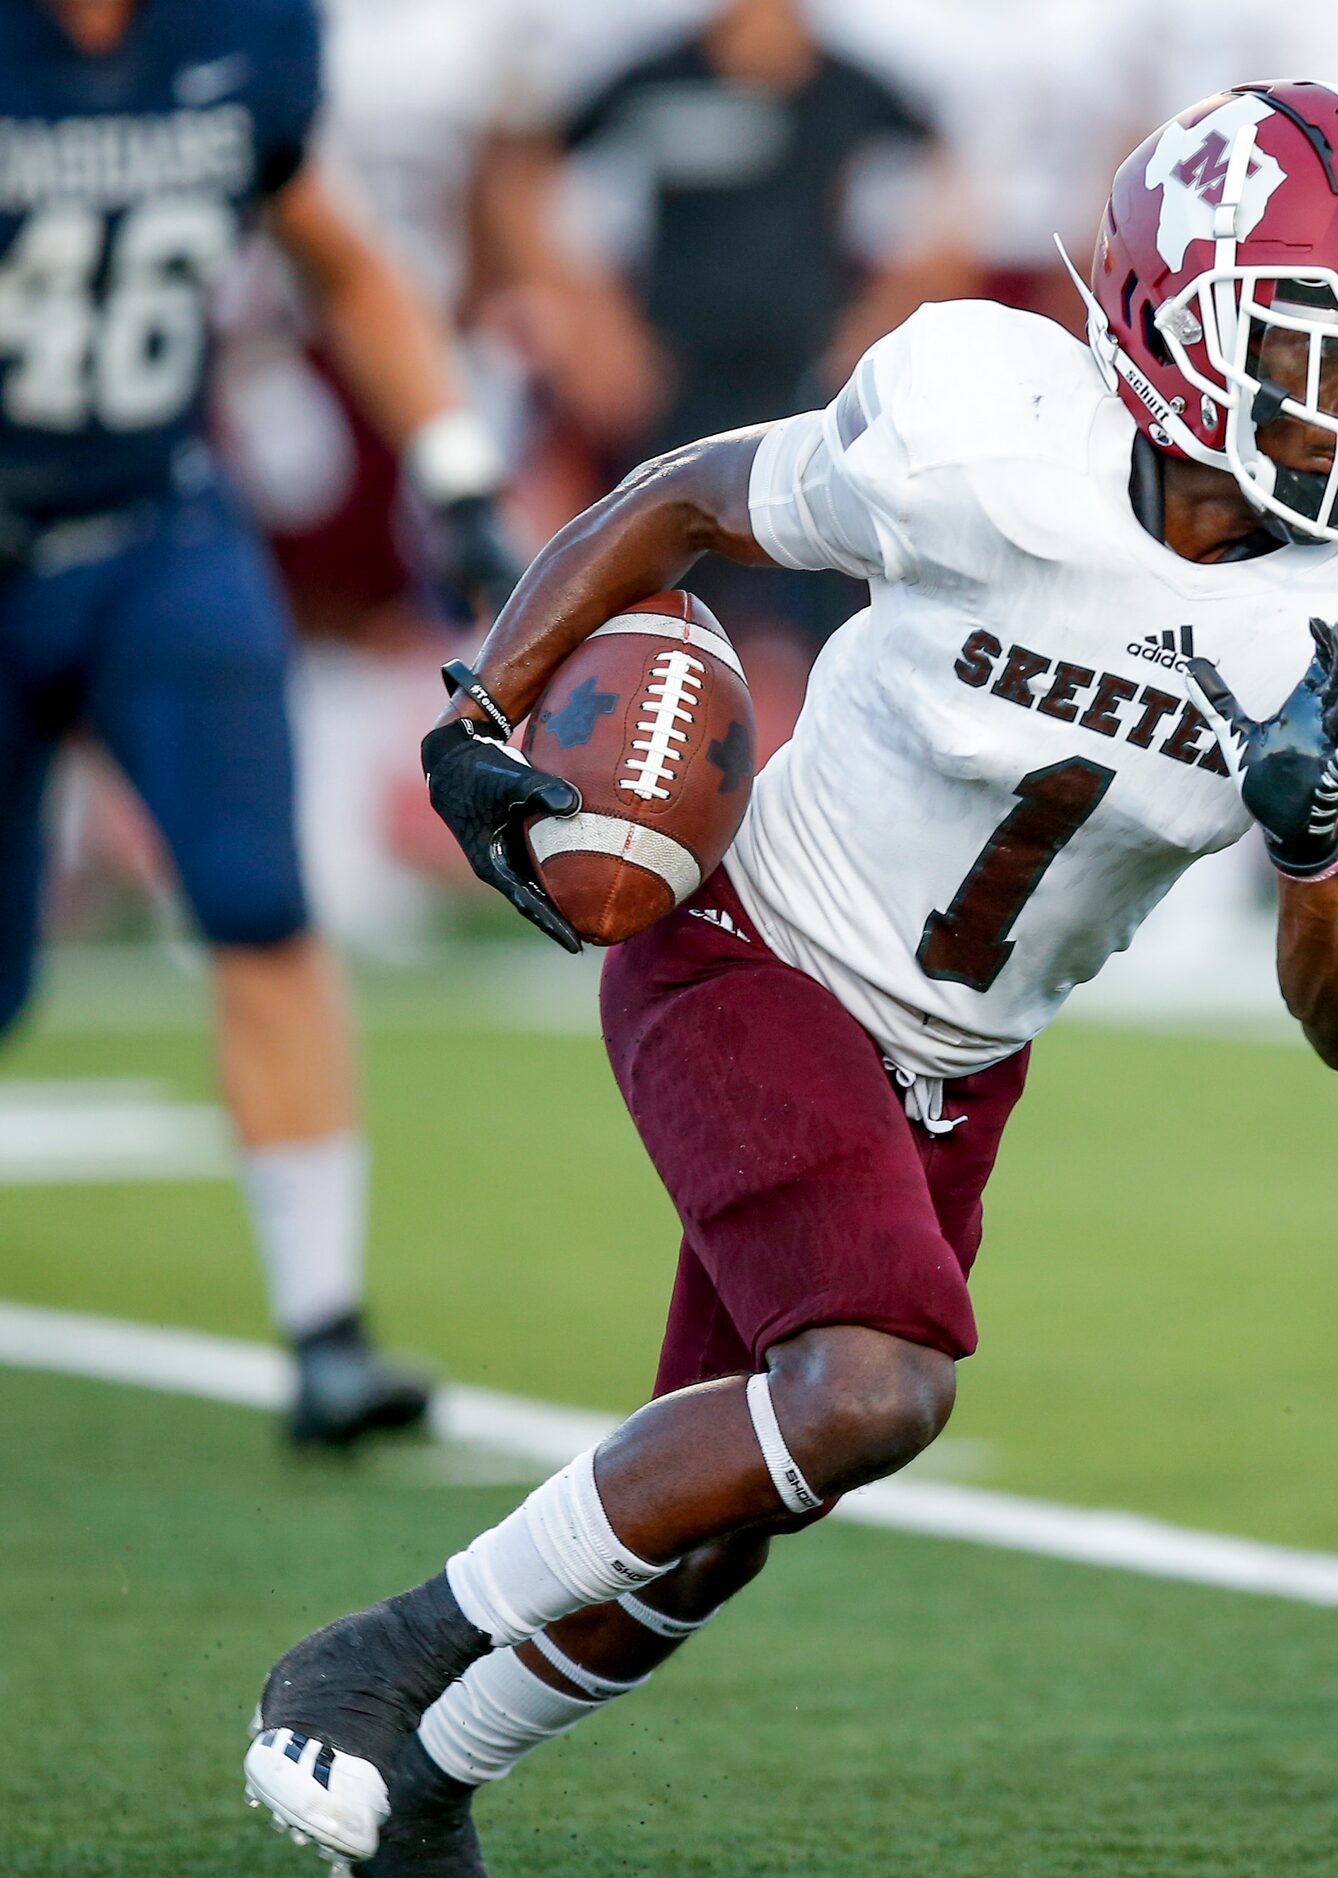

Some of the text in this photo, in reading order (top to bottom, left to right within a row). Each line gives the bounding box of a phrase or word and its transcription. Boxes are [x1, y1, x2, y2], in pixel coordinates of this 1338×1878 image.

[1126, 370, 1169, 422] schutt
[1126, 643, 1187, 673] adida
[915, 754, 1118, 994] 1
